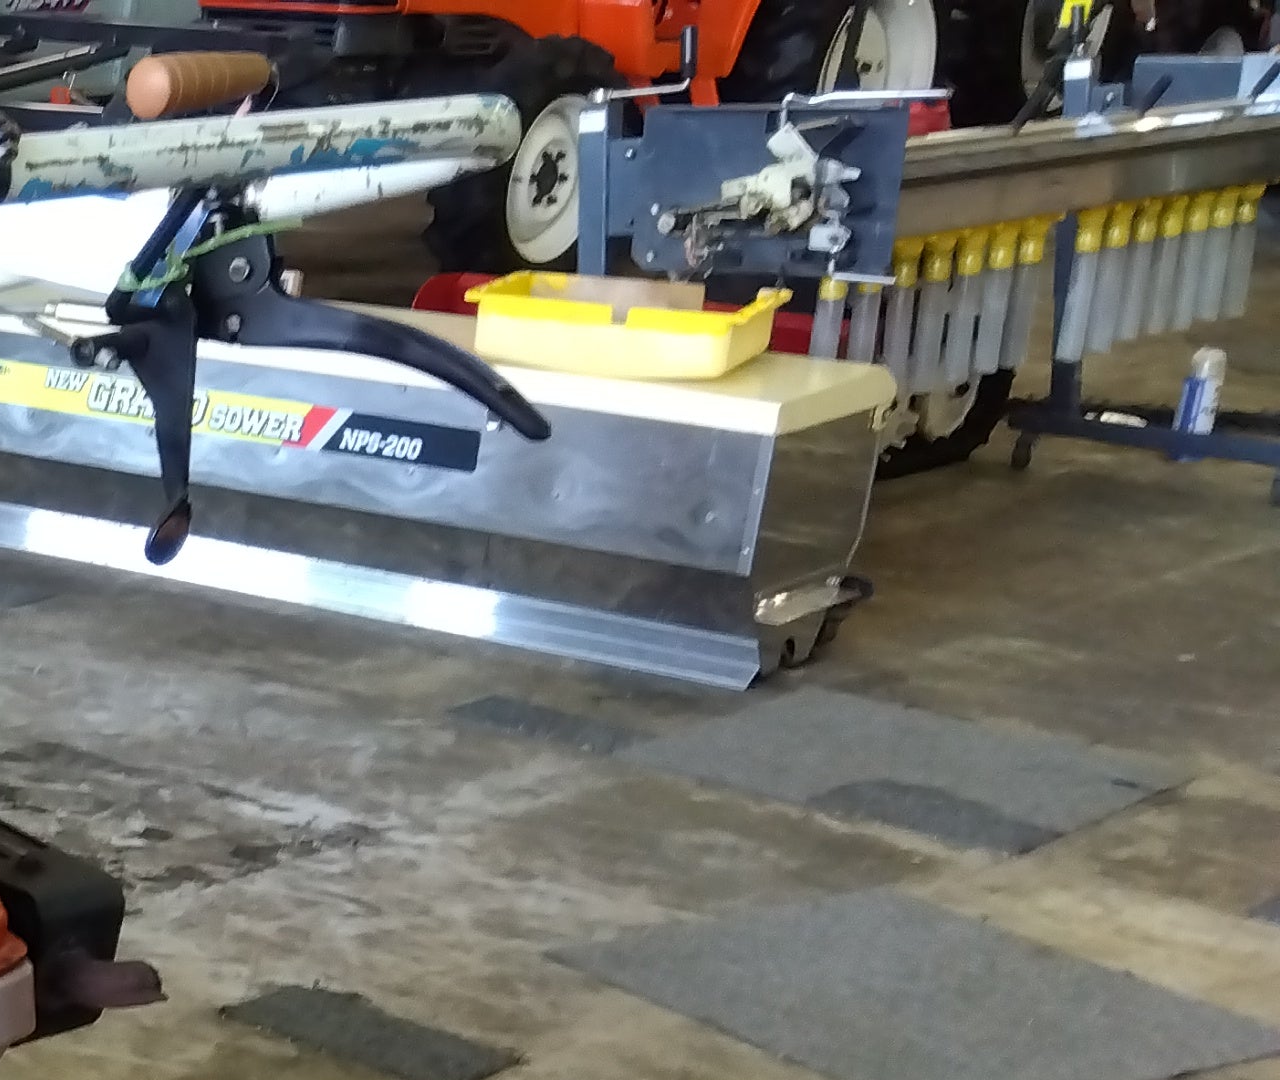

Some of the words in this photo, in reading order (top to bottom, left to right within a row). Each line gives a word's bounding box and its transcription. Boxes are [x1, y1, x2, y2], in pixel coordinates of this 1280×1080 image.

[44, 369, 89, 392] NEW
[87, 374, 210, 427] GRAD
[208, 403, 305, 441] SOWER
